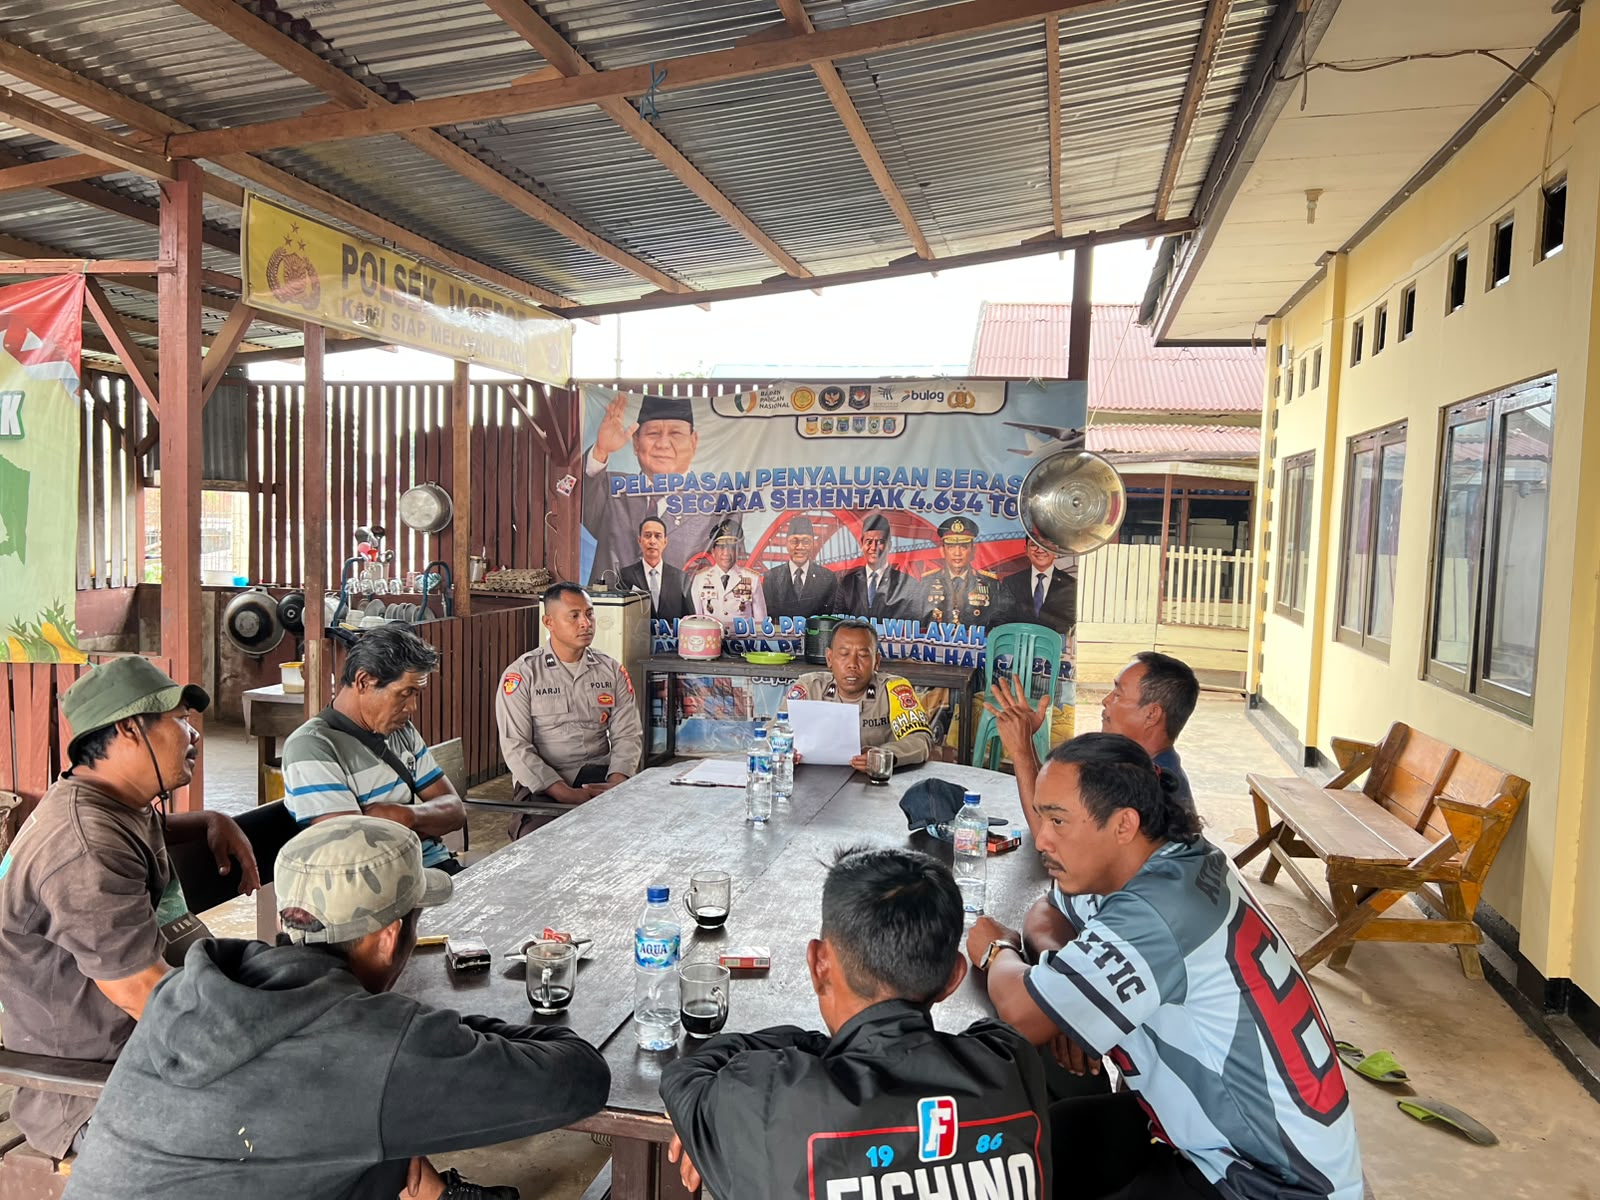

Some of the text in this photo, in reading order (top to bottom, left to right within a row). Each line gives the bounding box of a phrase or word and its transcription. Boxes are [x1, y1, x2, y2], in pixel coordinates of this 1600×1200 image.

[341, 242, 436, 311] POLSEK
[391, 312, 426, 338] SIAP
[911, 389, 944, 403] bulog
[611, 465, 1024, 496] PELEPASAN PENYALURAN BERAS
[666, 487, 1020, 518] SECARA SERENTAK 4.634 TO
[733, 616, 756, 638] DI
[761, 616, 775, 639] 6
[883, 617, 987, 646] WILAYAH
[535, 687, 561, 696] NARJI
[590, 681, 612, 689] POLRI
[639, 942, 668, 957] AQUA
[866, 1132, 1004, 1168] 19 86
